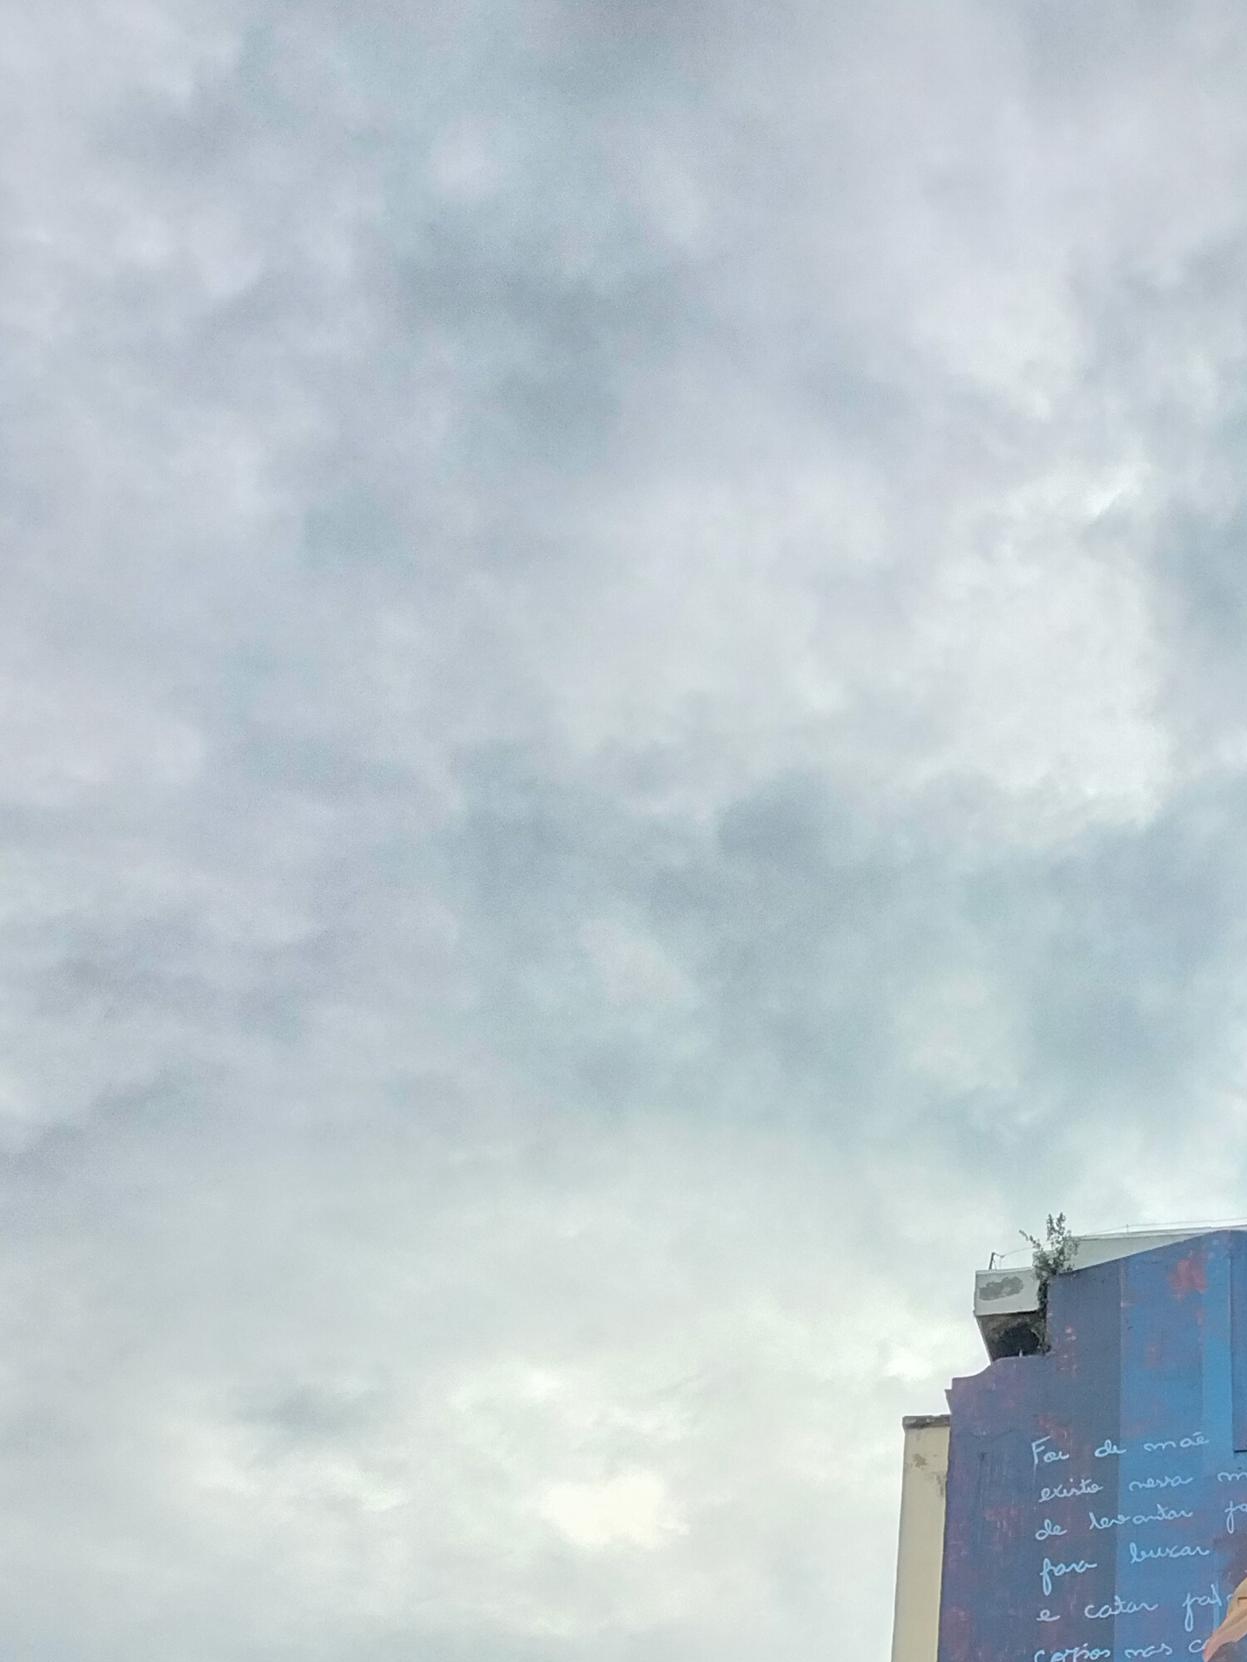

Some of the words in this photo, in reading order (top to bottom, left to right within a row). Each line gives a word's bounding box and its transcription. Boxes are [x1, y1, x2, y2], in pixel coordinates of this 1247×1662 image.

[1094, 1440, 1127, 1457] de
[1129, 1474, 1194, 1491] nessa
[1035, 1519, 1068, 1540] de
[1089, 1503, 1194, 1529] levantar
[1084, 1595, 1159, 1618] catar
